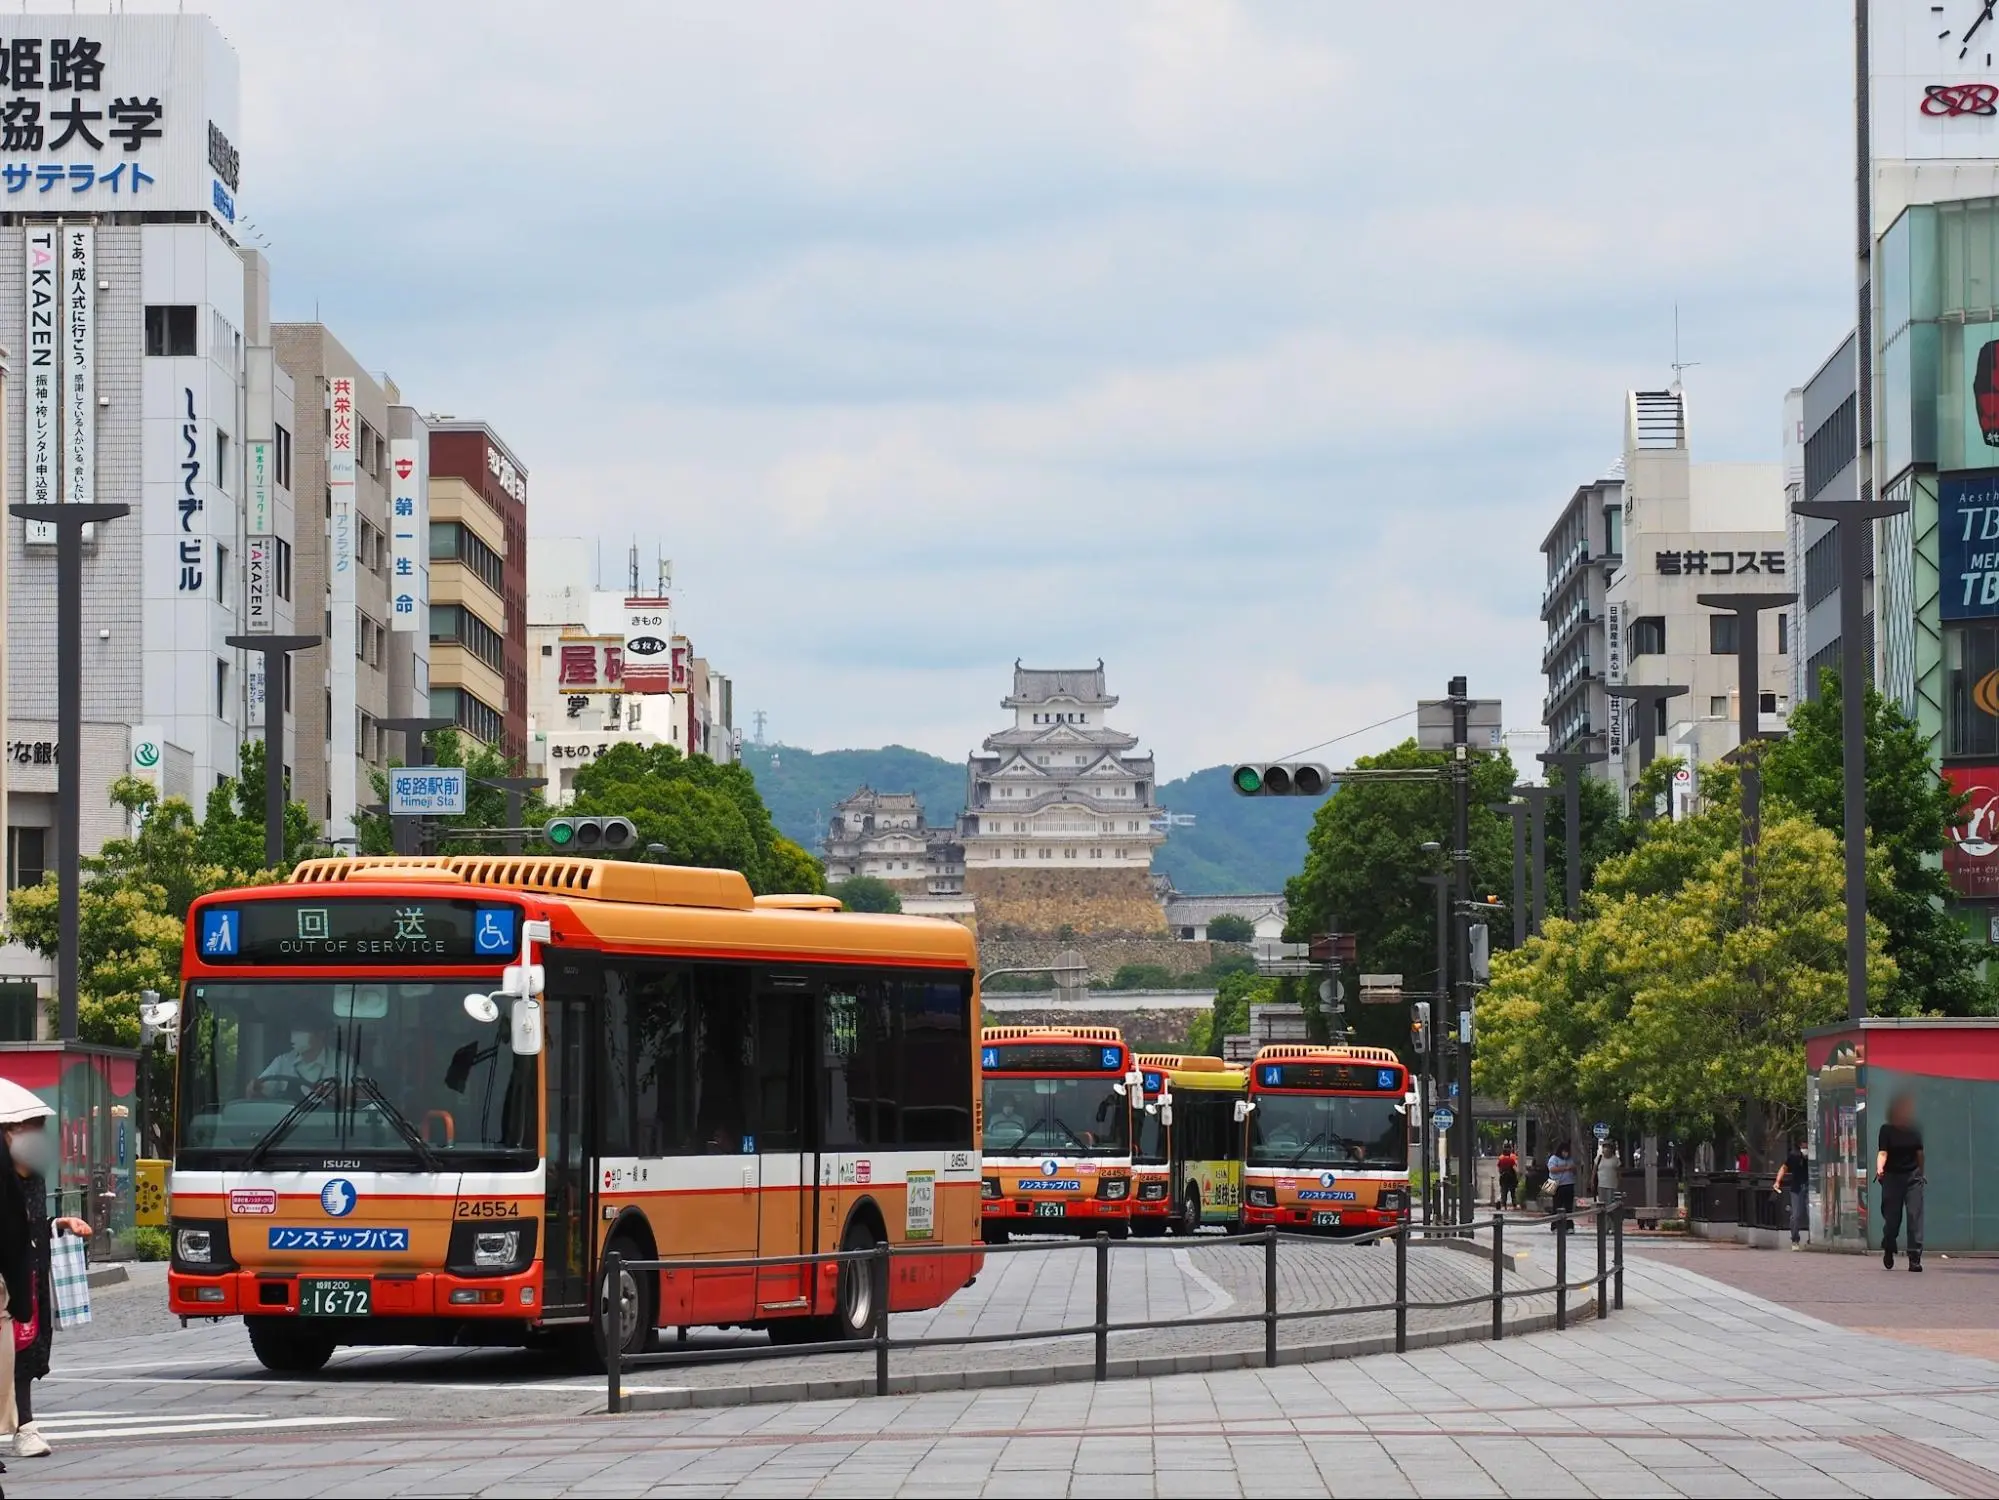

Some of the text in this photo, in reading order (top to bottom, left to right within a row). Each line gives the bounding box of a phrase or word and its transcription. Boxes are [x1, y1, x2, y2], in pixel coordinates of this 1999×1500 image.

[0, 37, 105, 91] 姫路
[2, 162, 154, 193] サテライト
[32, 233, 51, 366] TAKAZEN
[334, 379, 350, 449] 共栄火災
[178, 387, 203, 591] しらさぎビル
[395, 497, 413, 613] 第一生命
[1656, 550, 1785, 575] 岩井コスモ
[251, 541, 262, 616] TAKAZEN
[631, 616, 662, 626] きもの
[551, 744, 590, 758] きもの
[396, 777, 459, 795] 姫路駅前
[400, 796, 457, 808] Himeji Sta.
[280, 941, 445, 953] OUT OF SERVICE
[323, 1160, 360, 1168] ISUZU
[1019, 1181, 1080, 1190] ノンステップバス
[1299, 1191, 1355, 1200] ノンステップバス
[458, 1201, 518, 1217] 24554
[271, 1231, 404, 1248] ノンステップバス
[314, 1290, 368, 1314] 16-72
